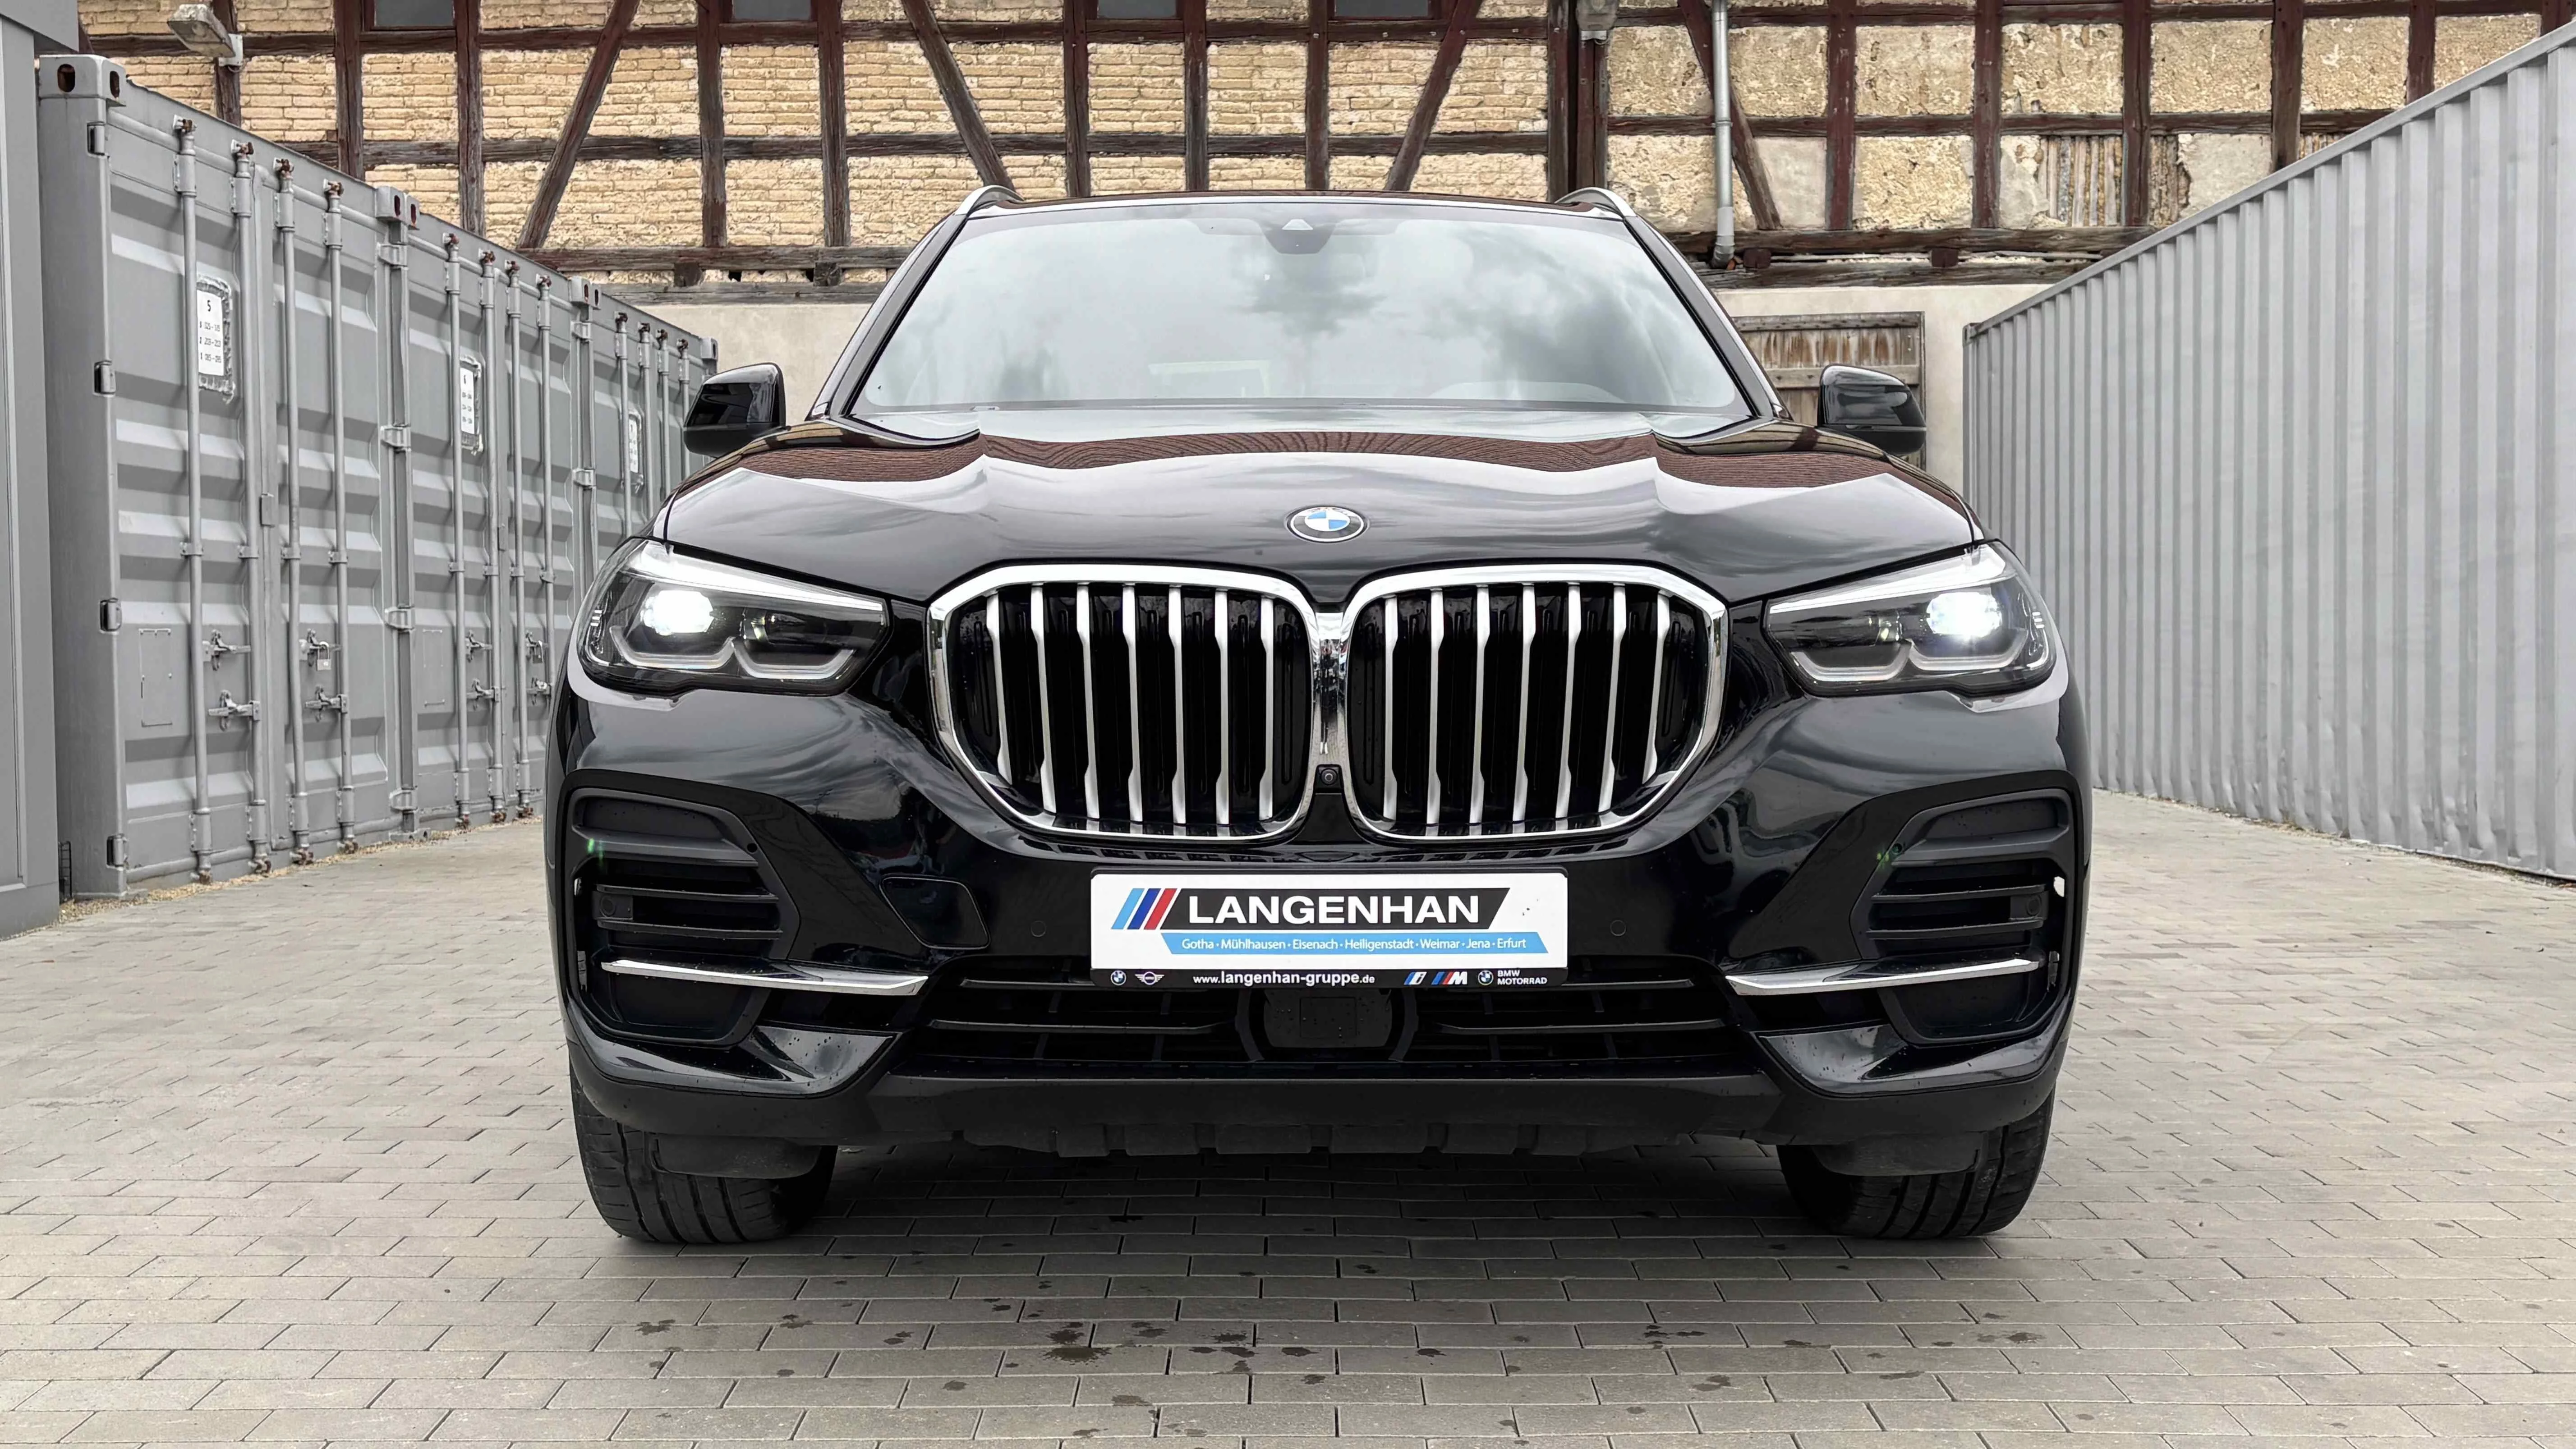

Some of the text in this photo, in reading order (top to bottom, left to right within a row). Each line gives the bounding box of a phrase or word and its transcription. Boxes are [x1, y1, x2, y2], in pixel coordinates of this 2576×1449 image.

[207, 300, 211, 312] 5
[1189, 895, 1478, 924] LANGENHAN
[1182, 938, 1526, 952] Gotha Mühlhausen Eisenach Heiligenstadt Weimar Jena Erfurt
[1193, 971, 1375, 986] www.langenhan-gruppe.de
[1449, 972, 1467, 985] M
[1497, 977, 1547, 985] MOTORRAD
